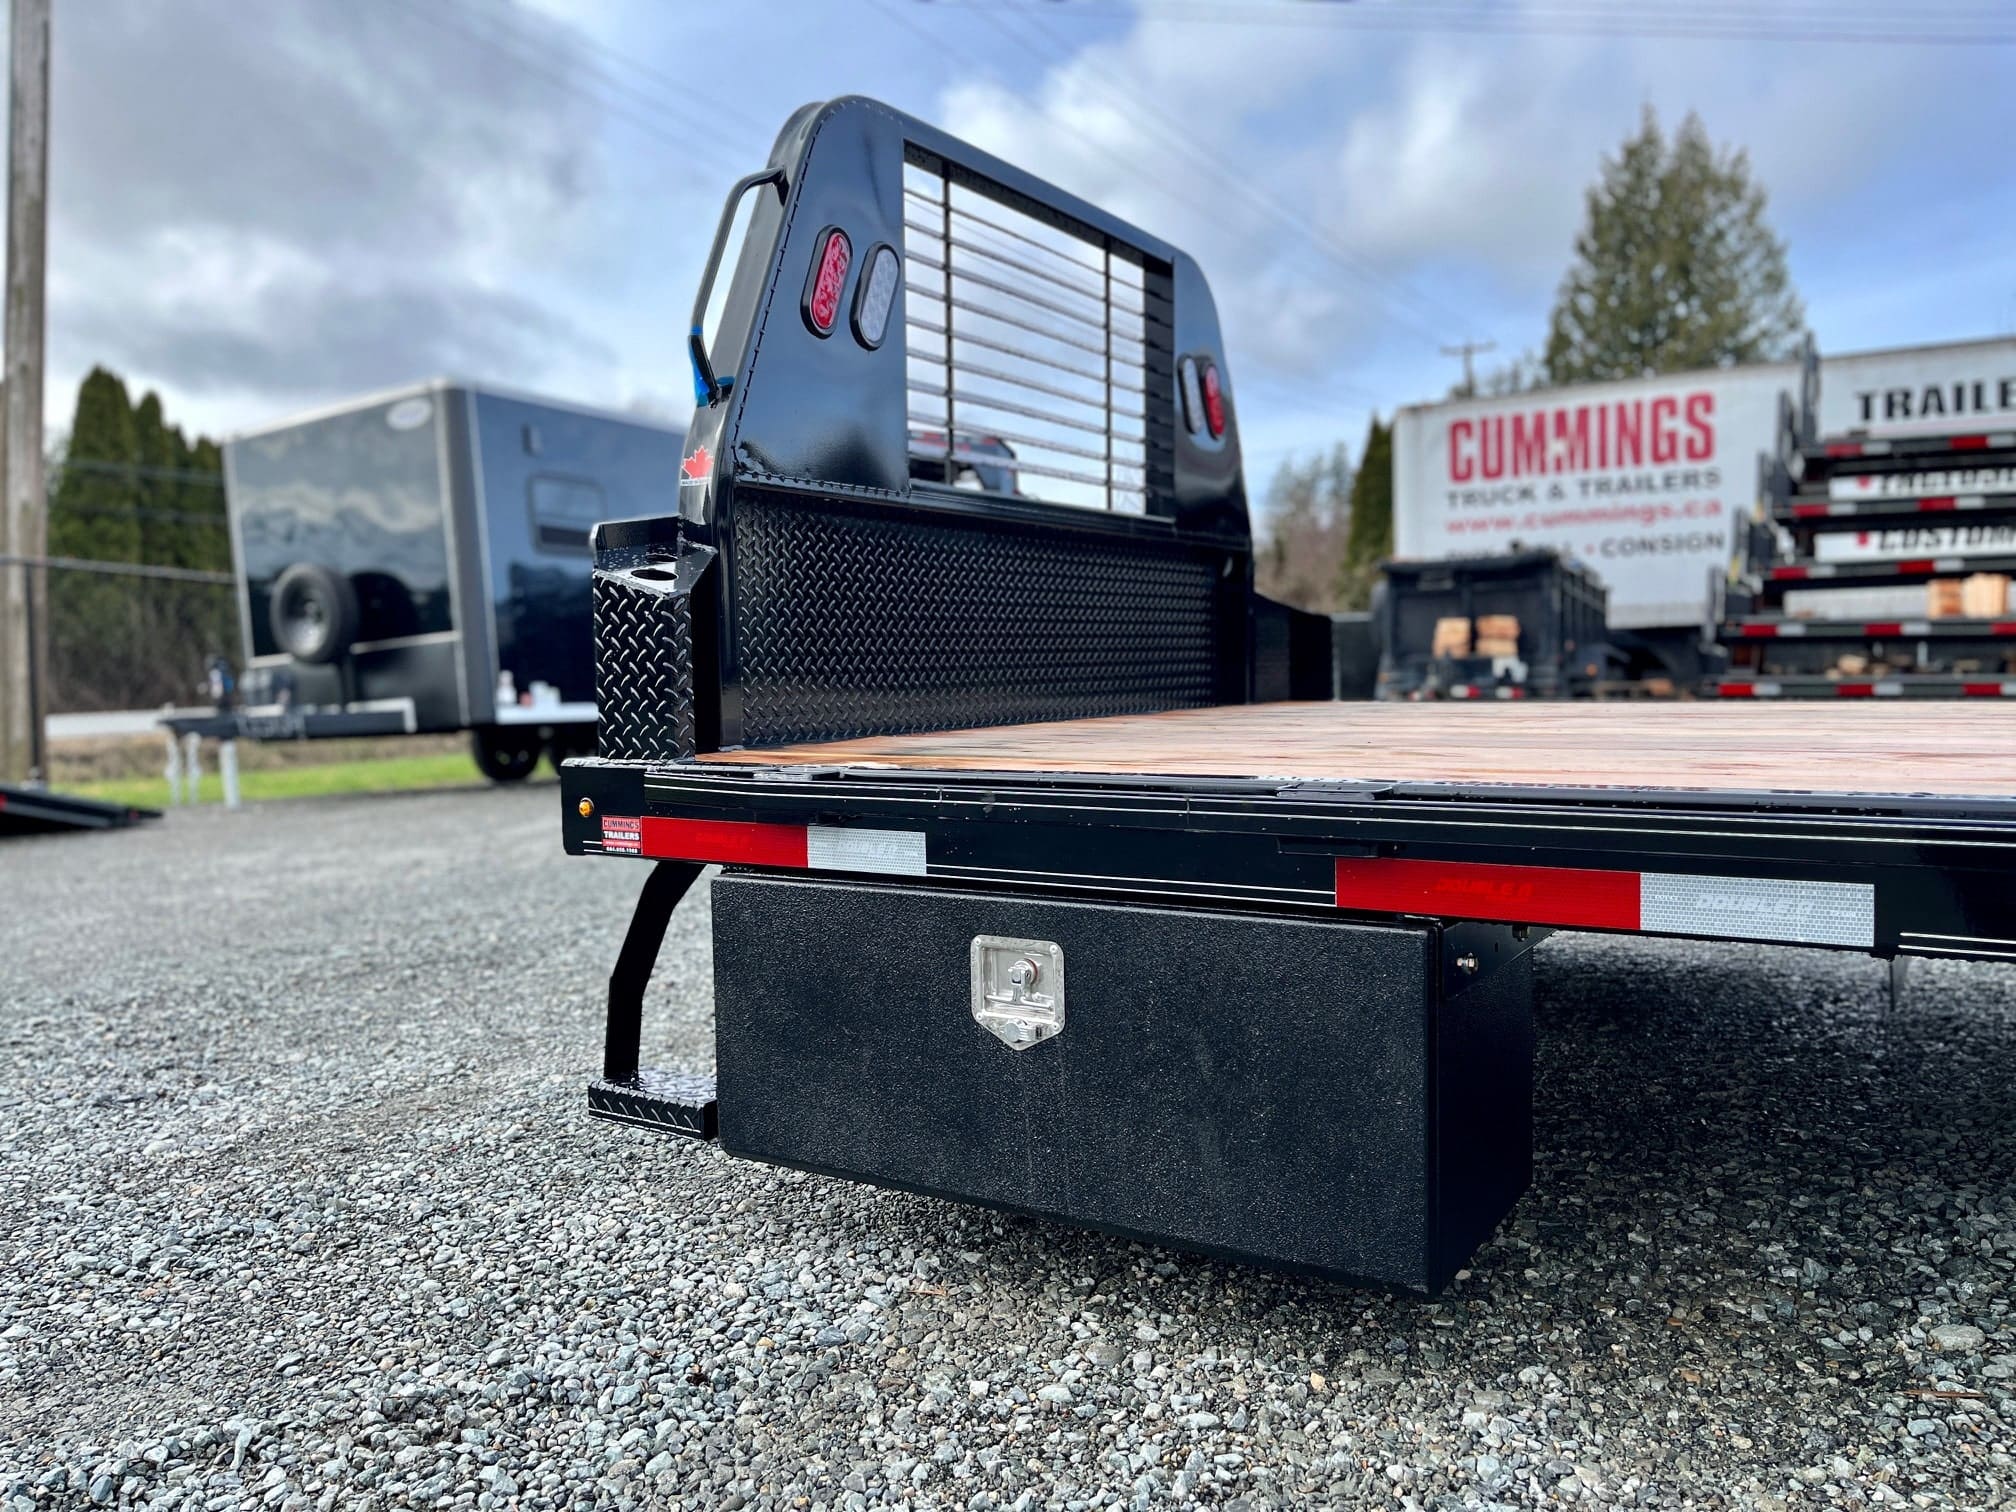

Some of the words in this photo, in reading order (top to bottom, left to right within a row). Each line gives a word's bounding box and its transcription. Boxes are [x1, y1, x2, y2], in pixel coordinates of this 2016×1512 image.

[1855, 378, 2016, 422] TRAILE
[1448, 392, 1716, 482] CUMMINGS
[1447, 483, 1538, 509] TRUCK
[1578, 466, 1722, 498] TRAILERS
[1447, 501, 1722, 533] www.cummings.ca
[1600, 532, 1725, 558] CONSIGN
[603, 819, 640, 829] CUMMINGS
[603, 830, 640, 840] TRAILERS
